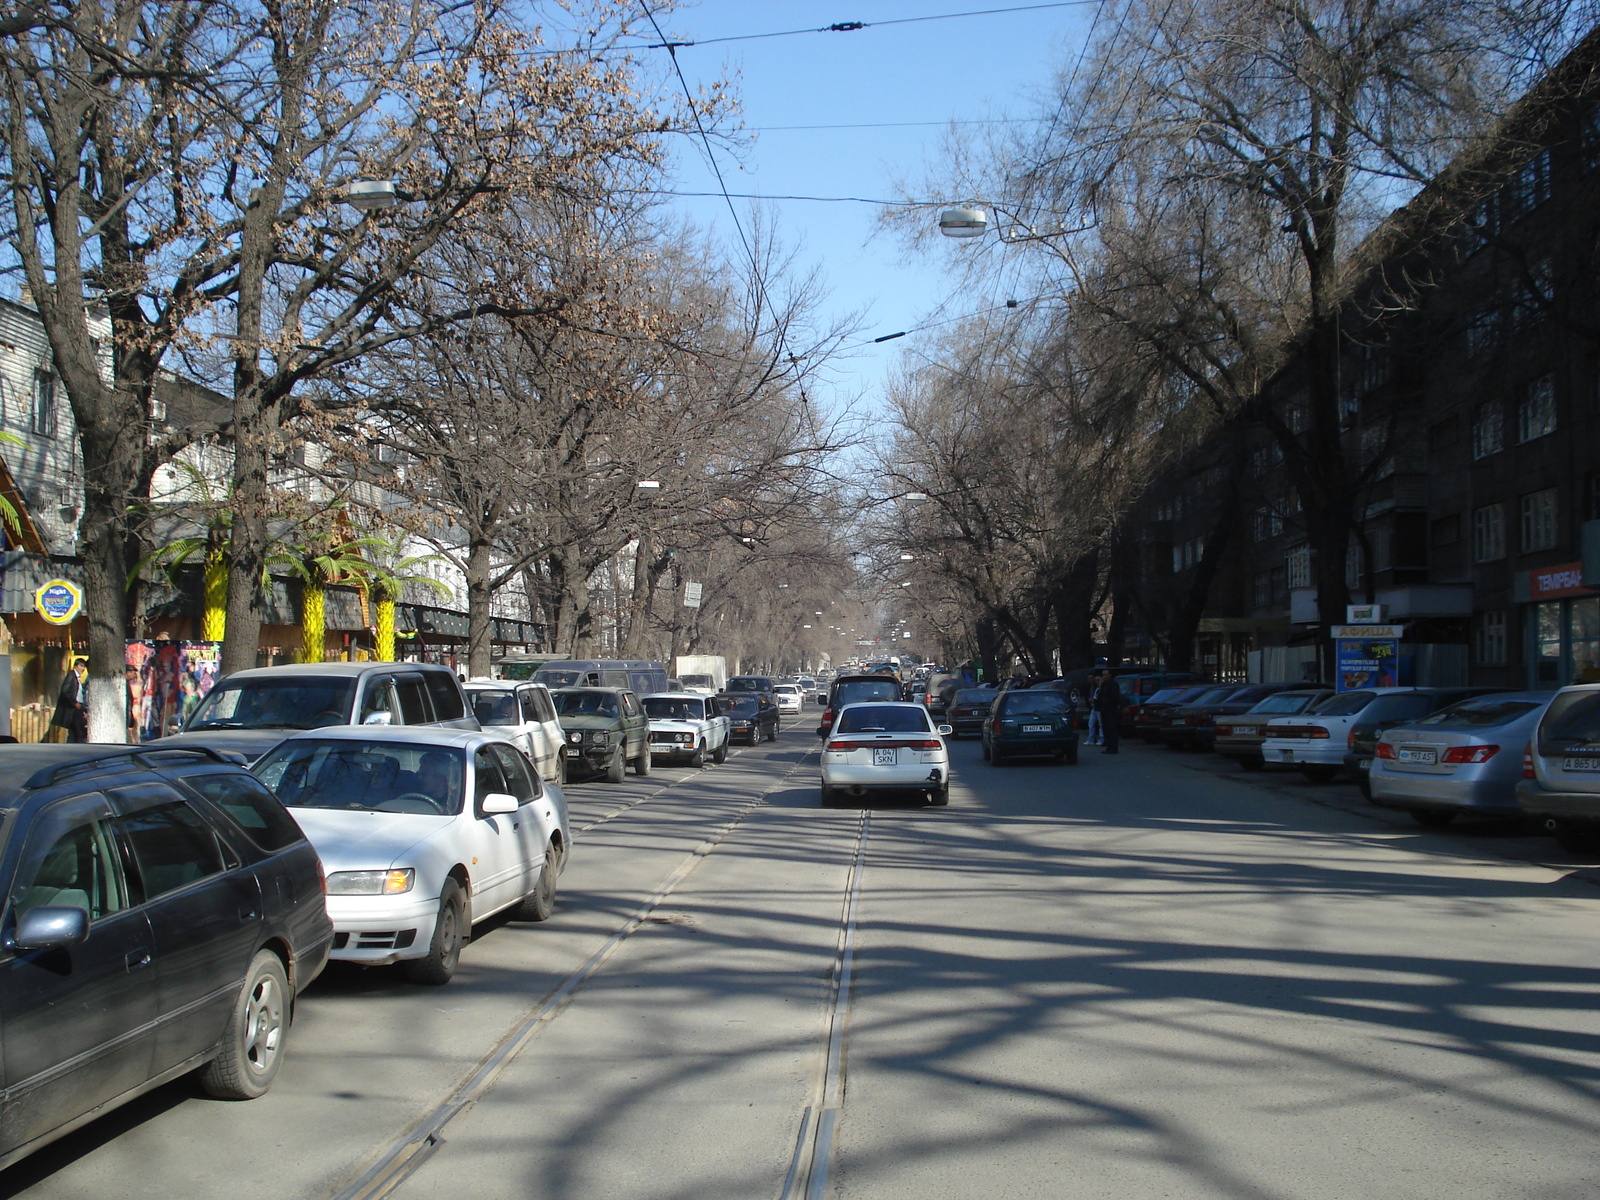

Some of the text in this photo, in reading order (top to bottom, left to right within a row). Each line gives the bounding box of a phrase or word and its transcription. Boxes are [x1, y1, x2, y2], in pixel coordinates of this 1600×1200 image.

[1339, 626, 1395, 637] АФИША
[875, 748, 895, 756] A 047
[1565, 759, 1572, 768] A
[1574, 759, 1590, 769] 865
